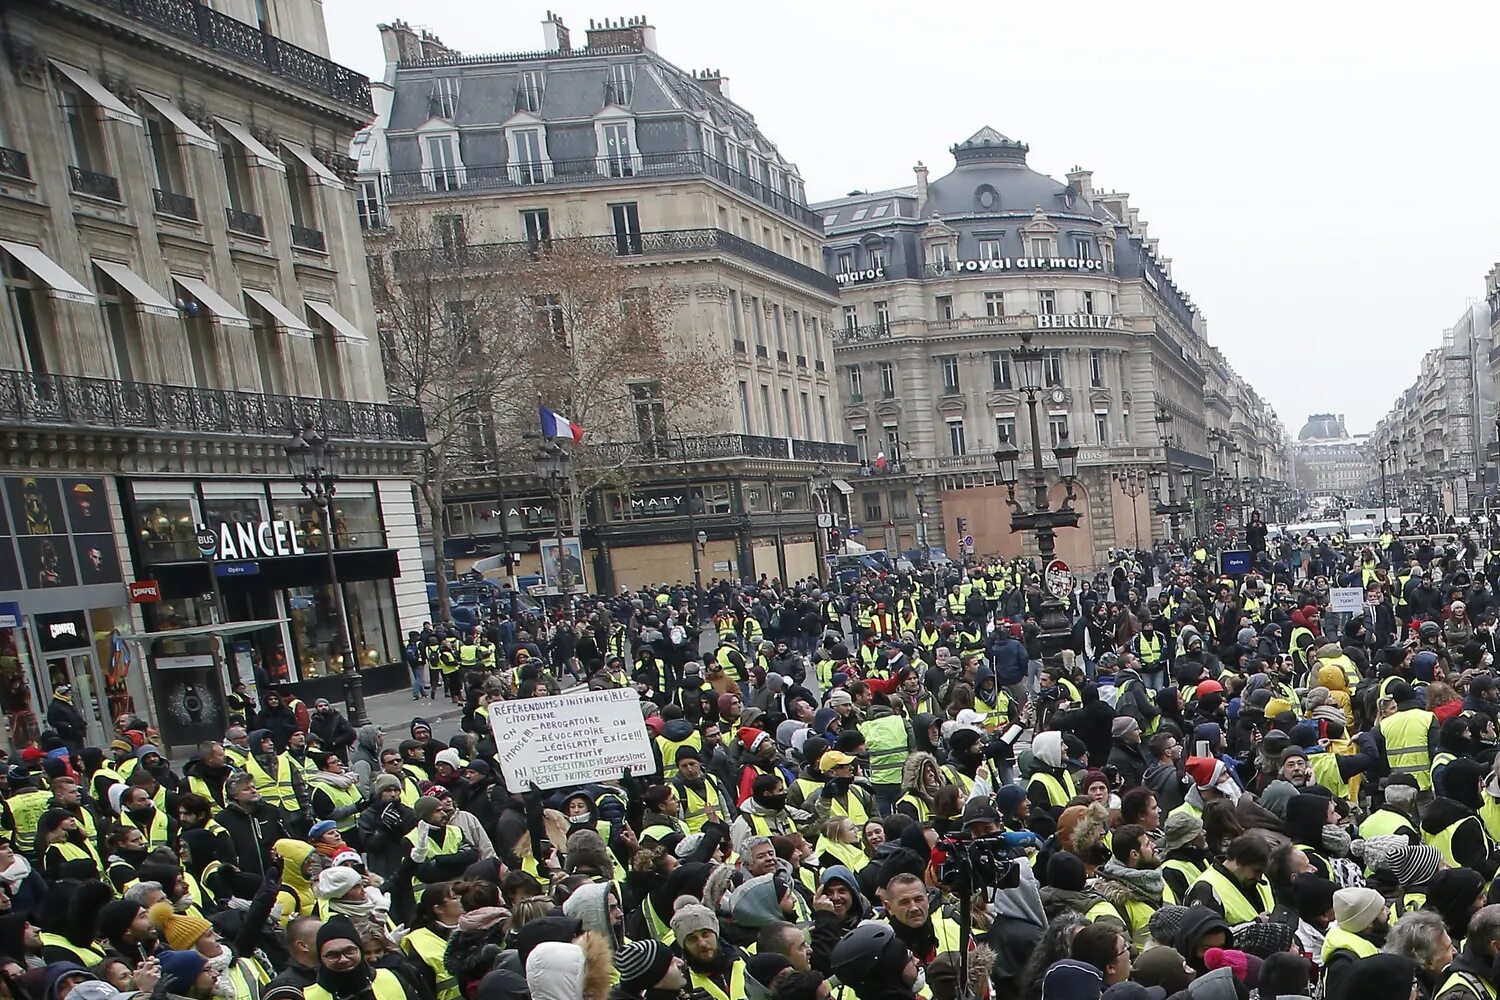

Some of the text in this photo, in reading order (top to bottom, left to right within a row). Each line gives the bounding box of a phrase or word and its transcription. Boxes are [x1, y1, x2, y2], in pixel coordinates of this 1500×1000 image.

[956, 257, 1102, 273] royal air maroc
[836, 265, 885, 284] maroc
[1037, 314, 1111, 329] BERLITZ
[631, 495, 684, 508] MATY
[197, 535, 215, 544] BUS
[197, 520, 304, 560] ANCEL
[1229, 557, 1244, 567] Opéra
[228, 565, 245, 573] Opéra
[50, 622, 77, 638] CAMPER
[494, 699, 558, 716] RÉFÉRENDUMS
[612, 690, 630, 701] RIC
[506, 712, 556, 725] CITOYENNE
[613, 719, 627, 727] ON
[503, 728, 517, 741] ON
[514, 767, 528, 779] NI
[594, 763, 647, 777] CONSTITTION
